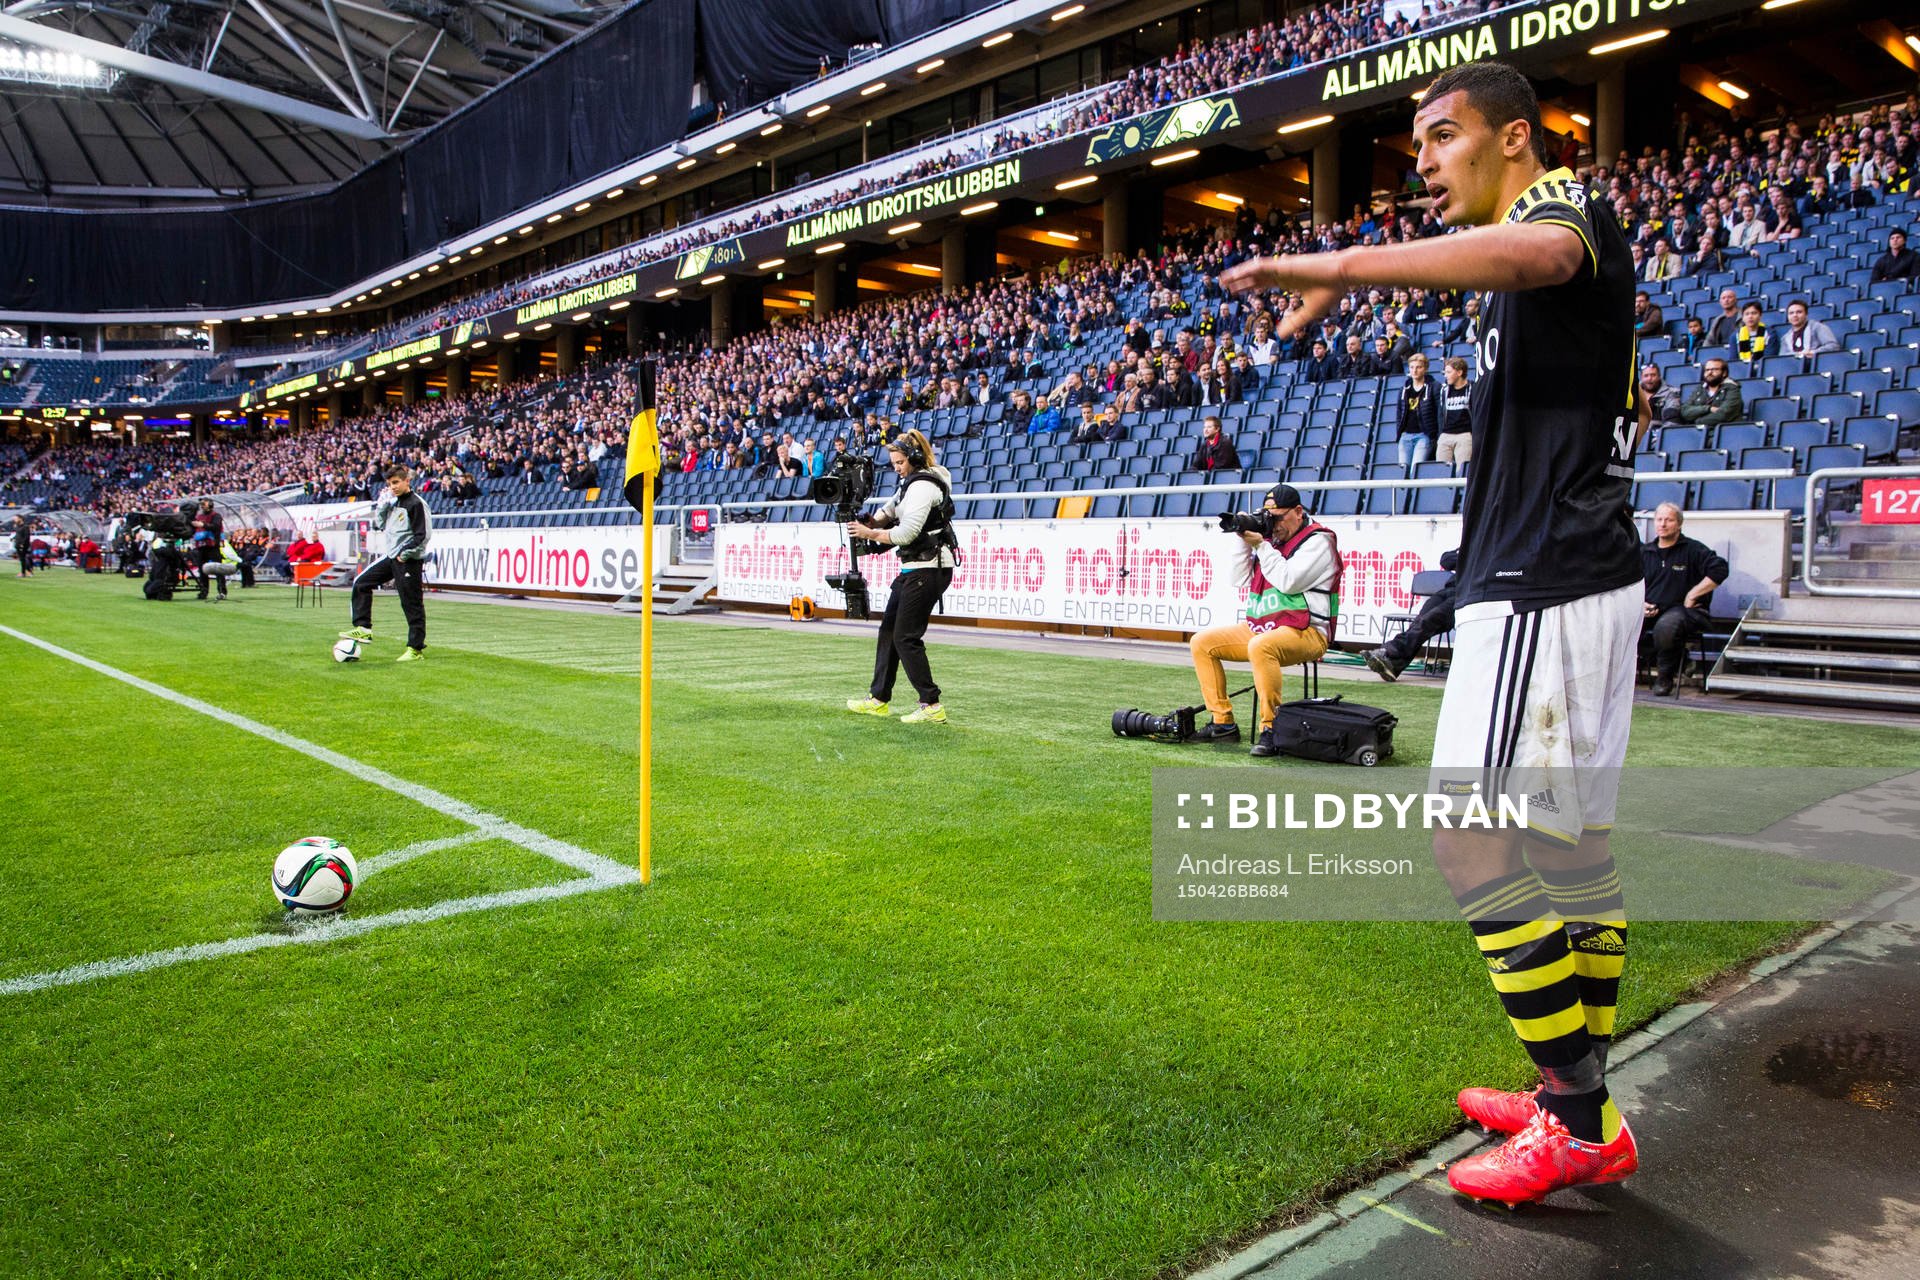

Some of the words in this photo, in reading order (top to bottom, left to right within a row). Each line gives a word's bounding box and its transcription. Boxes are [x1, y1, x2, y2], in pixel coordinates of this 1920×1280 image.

[1322, 25, 1498, 100] ALLMÄNNA
[1509, 0, 1687, 50] IDROTT
[787, 205, 863, 247] ALLMÄNNA
[867, 159, 1020, 224] IDROTTSKLUBBEN
[516, 298, 559, 325] ALLMÄNNA
[559, 273, 637, 313] IDROTTSKLUBBEN
[694, 515, 707, 527] 128
[1870, 489, 1920, 514] 127
[433, 535, 639, 590] www.nolimo.se
[724, 528, 804, 582] nolimo
[950, 528, 1046, 593] olimo
[1065, 527, 1213, 600] nolimo
[944, 594, 1046, 617] TREPRENAD
[1063, 600, 1212, 627] ENTREPRENAD
